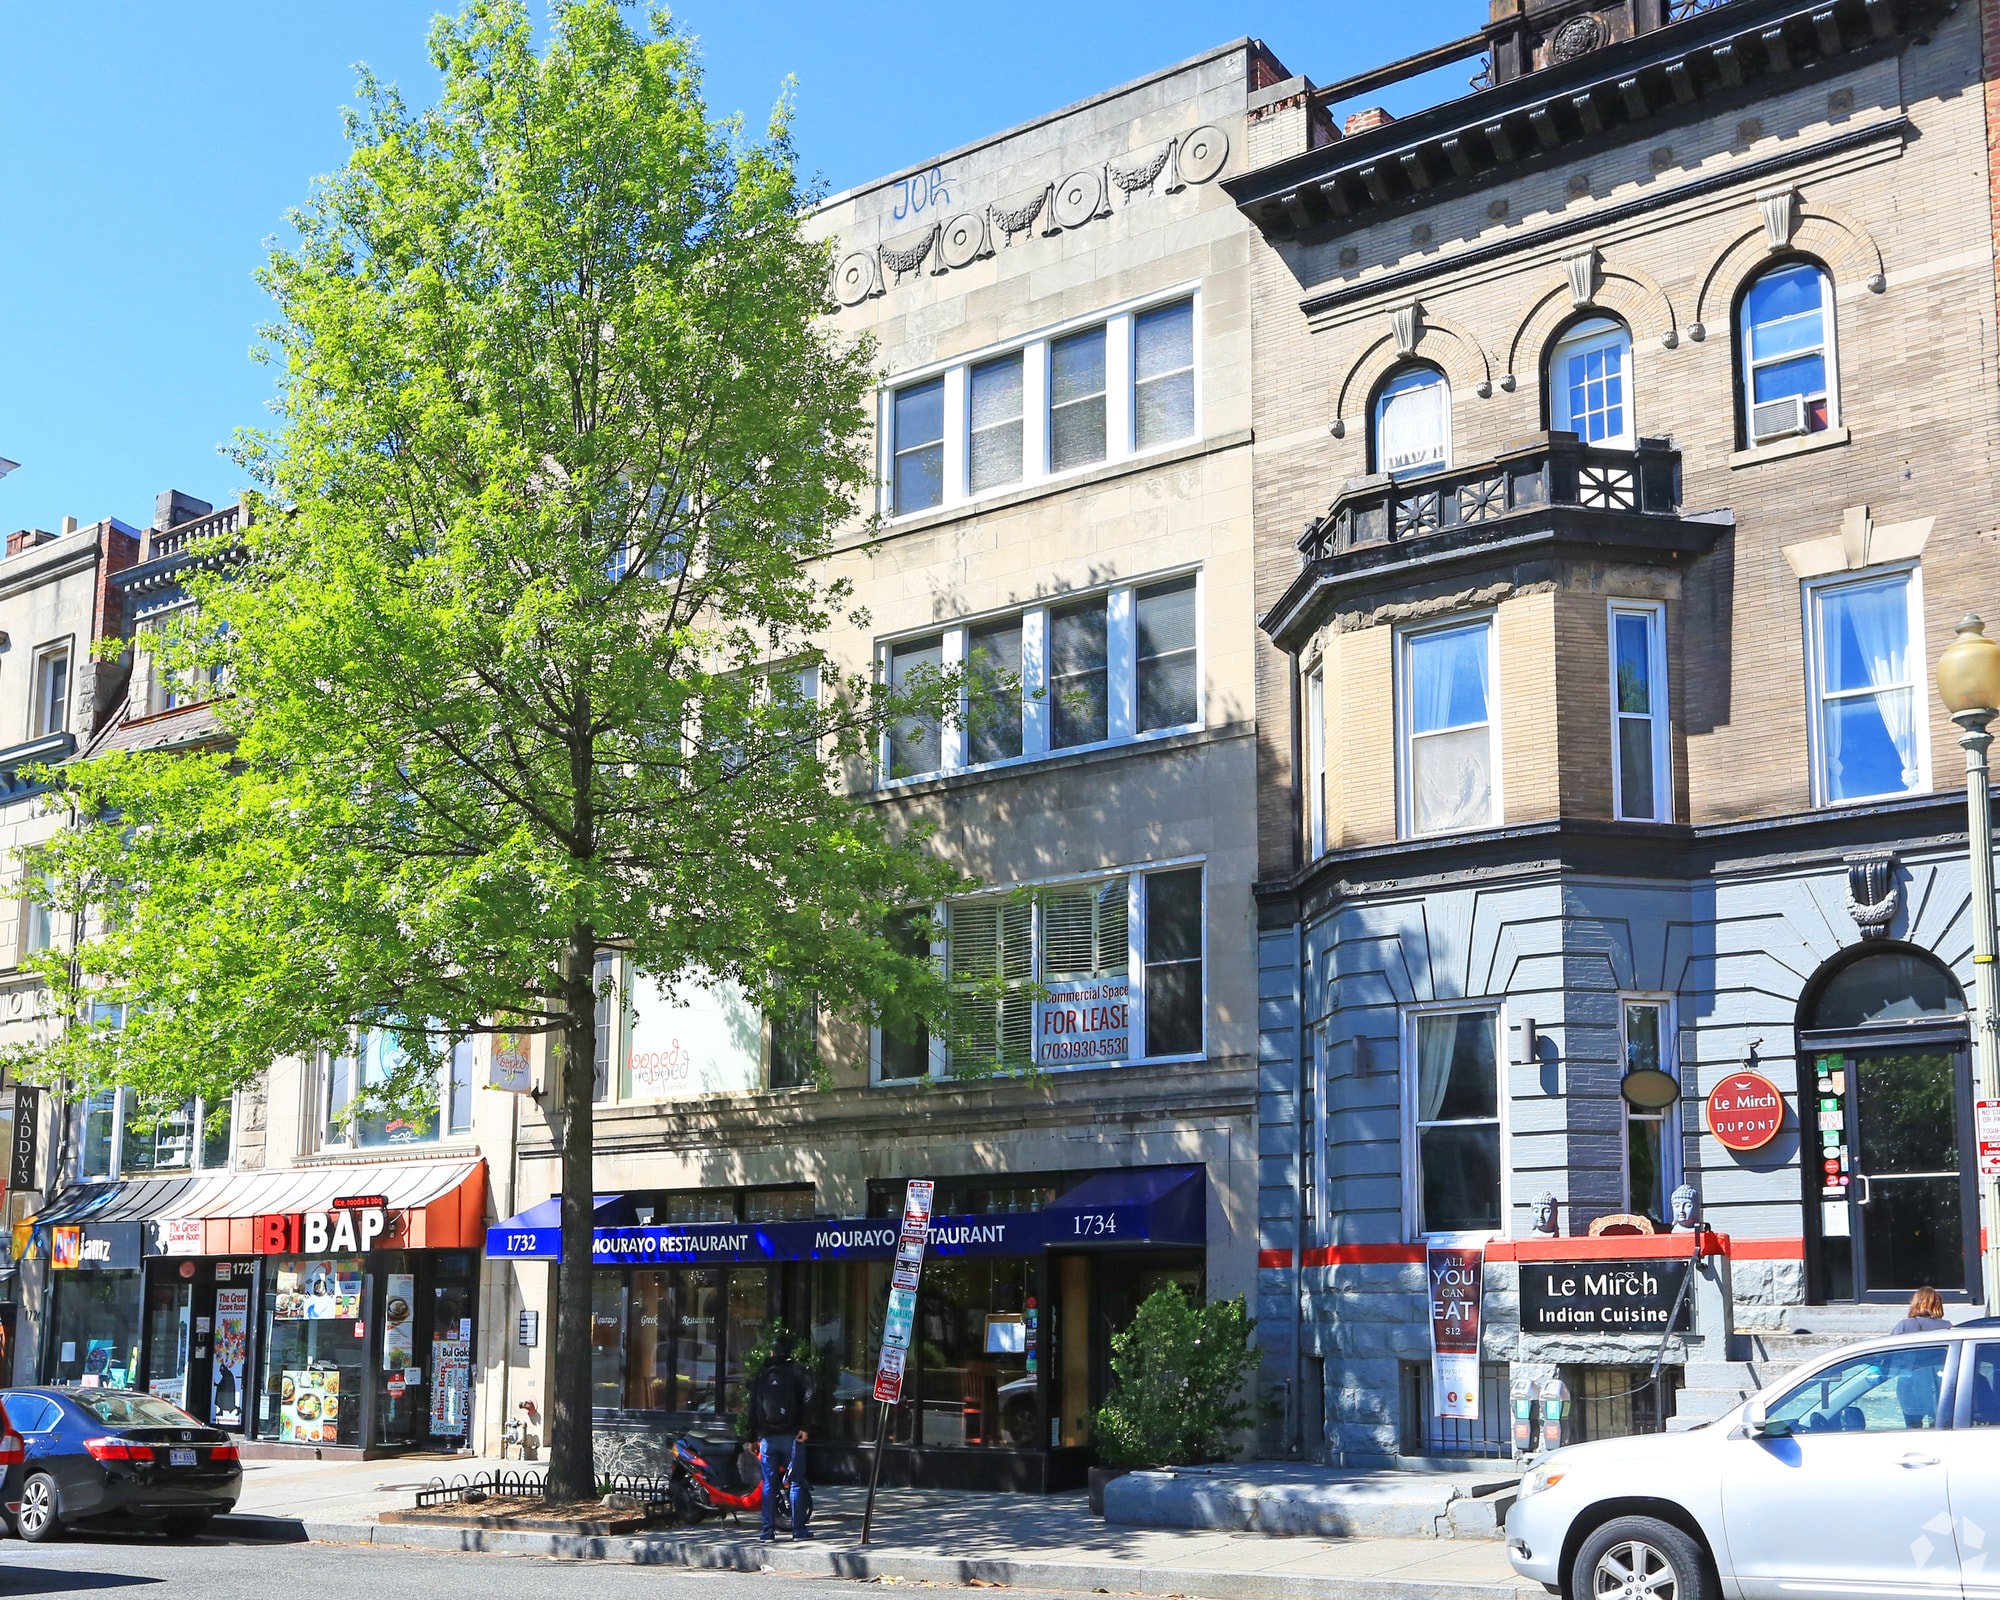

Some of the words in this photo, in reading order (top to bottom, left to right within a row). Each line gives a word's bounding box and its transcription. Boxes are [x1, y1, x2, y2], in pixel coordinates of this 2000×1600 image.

[1045, 986, 1100, 1004] Commercial
[1103, 984, 1129, 1000] Space
[1044, 1010, 1077, 1035] FOR
[1082, 1004, 1129, 1032] LEASE
[1041, 1037, 1129, 1060] (703)930-5530
[1714, 1097, 1730, 1110] Le
[1736, 1092, 1777, 1108] Mirch
[1716, 1119, 1775, 1133] DUPONT
[18, 1095, 34, 1184] MADDY'S
[169, 1221, 181, 1232] The
[182, 1221, 200, 1232] Great
[263, 1209, 385, 1254] BIBAP
[1073, 1215, 1117, 1235] 1734
[506, 1234, 536, 1252] 1732
[592, 1237, 656, 1254] MOURAYO
[660, 1234, 748, 1252] RESTAURANT
[815, 1229, 895, 1248] MOURAYO
[926, 1225, 1005, 1245] TAURANT
[1444, 1257, 1465, 1267] ALL
[1433, 1269, 1474, 1286] YOU
[1547, 1275, 1575, 1297] Le
[1584, 1271, 1658, 1297] Mirch
[219, 1293, 230, 1303] The
[231, 1293, 246, 1303] Great
[1442, 1289, 1465, 1298] CAN
[1433, 1301, 1474, 1321] EAT
[1539, 1307, 1594, 1322] Indian
[1601, 1307, 1668, 1323] Cuisine
[640, 1315, 658, 1327] Greek
[1445, 1327, 1461, 1336] $12
[442, 1348, 452, 1357] Bul
[438, 1366, 447, 1388] Bap
